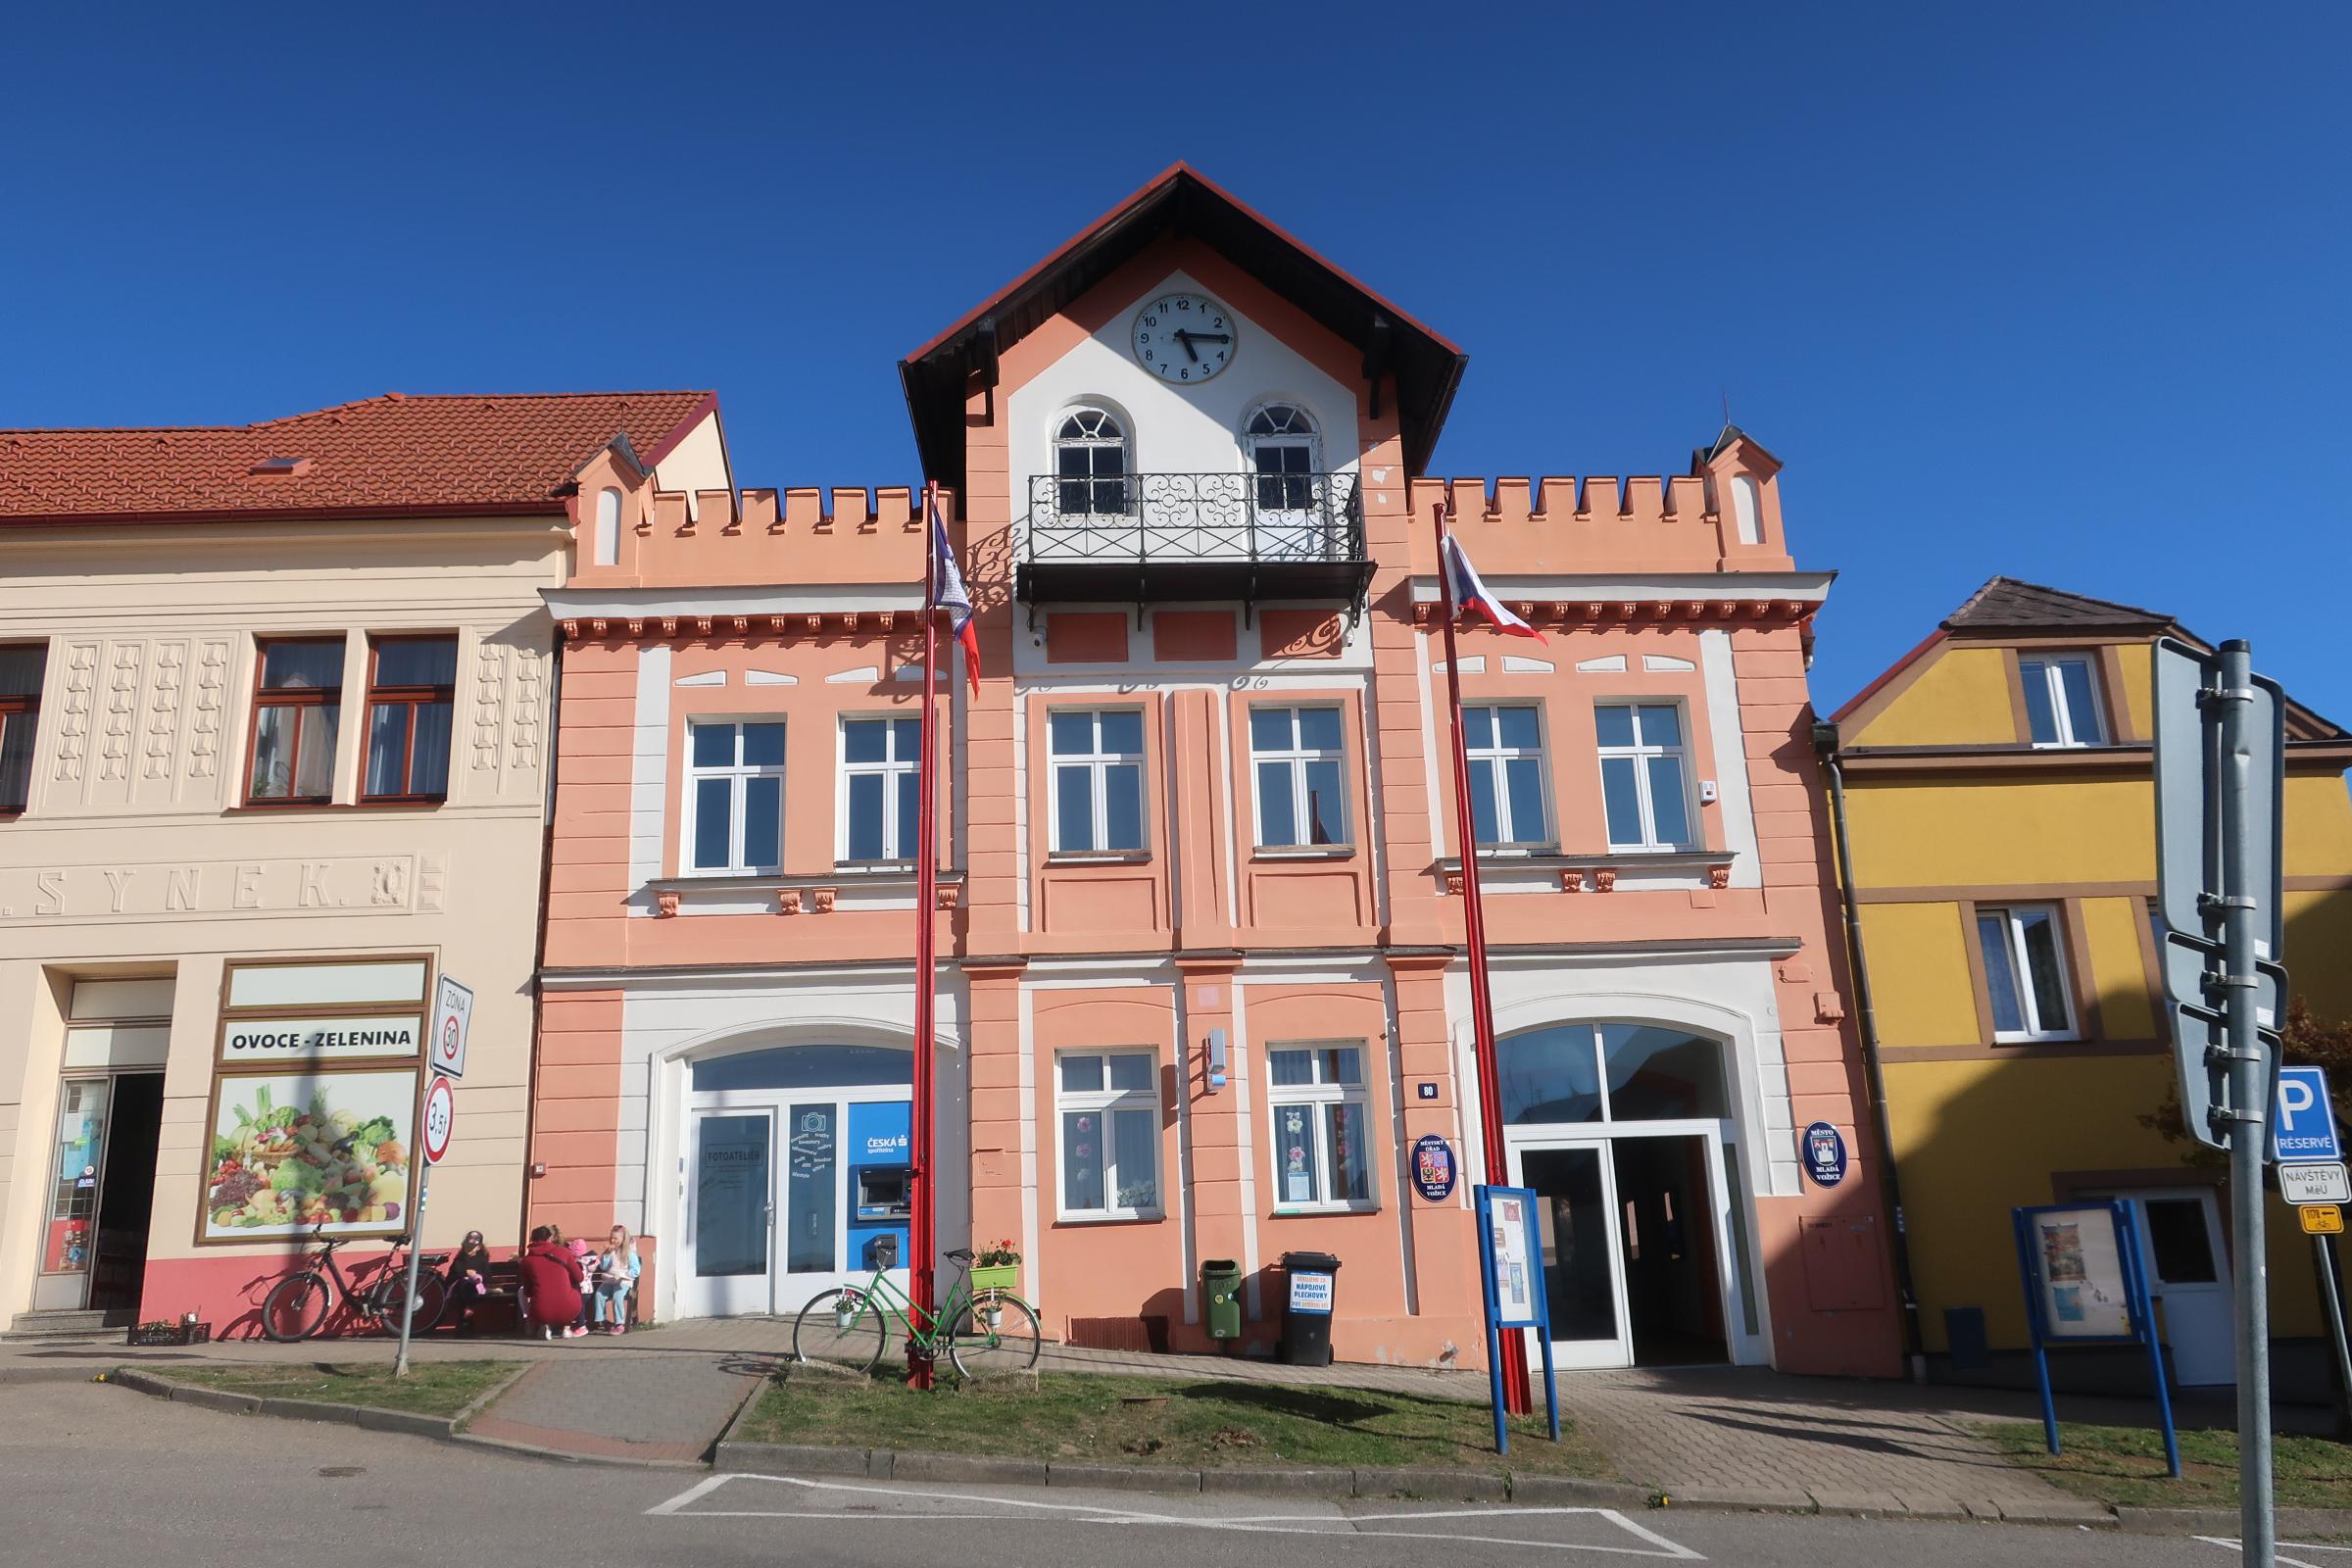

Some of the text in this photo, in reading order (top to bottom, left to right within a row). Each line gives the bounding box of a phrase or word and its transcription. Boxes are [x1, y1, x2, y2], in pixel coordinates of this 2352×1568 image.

[1158, 303, 1168, 314] 11
[1176, 300, 1190, 311] 12
[1200, 304, 1205, 314] 1
[1144, 316, 1156, 327] 10
[1214, 318, 1222, 328] 2
[1141, 333, 1150, 344] 9
[1146, 350, 1152, 361] 8
[1216, 351, 1224, 362] 4
[1160, 364, 1167, 374] 7
[1181, 368, 1189, 379] 6
[1202, 364, 1210, 374] 5
[445, 988, 466, 1013] ZÓNA
[231, 1033, 300, 1050] OVOCE
[314, 1030, 411, 1047] ZELENINA
[445, 1026, 456, 1049] 30
[1423, 1086, 1434, 1097] 80
[2278, 1079, 2314, 1131] P
[867, 1137, 897, 1148] ČESKÁ
[2278, 1136, 2332, 1150] RÉSERVÉ
[1295, 1291, 1328, 1299] PLECHOVKY
